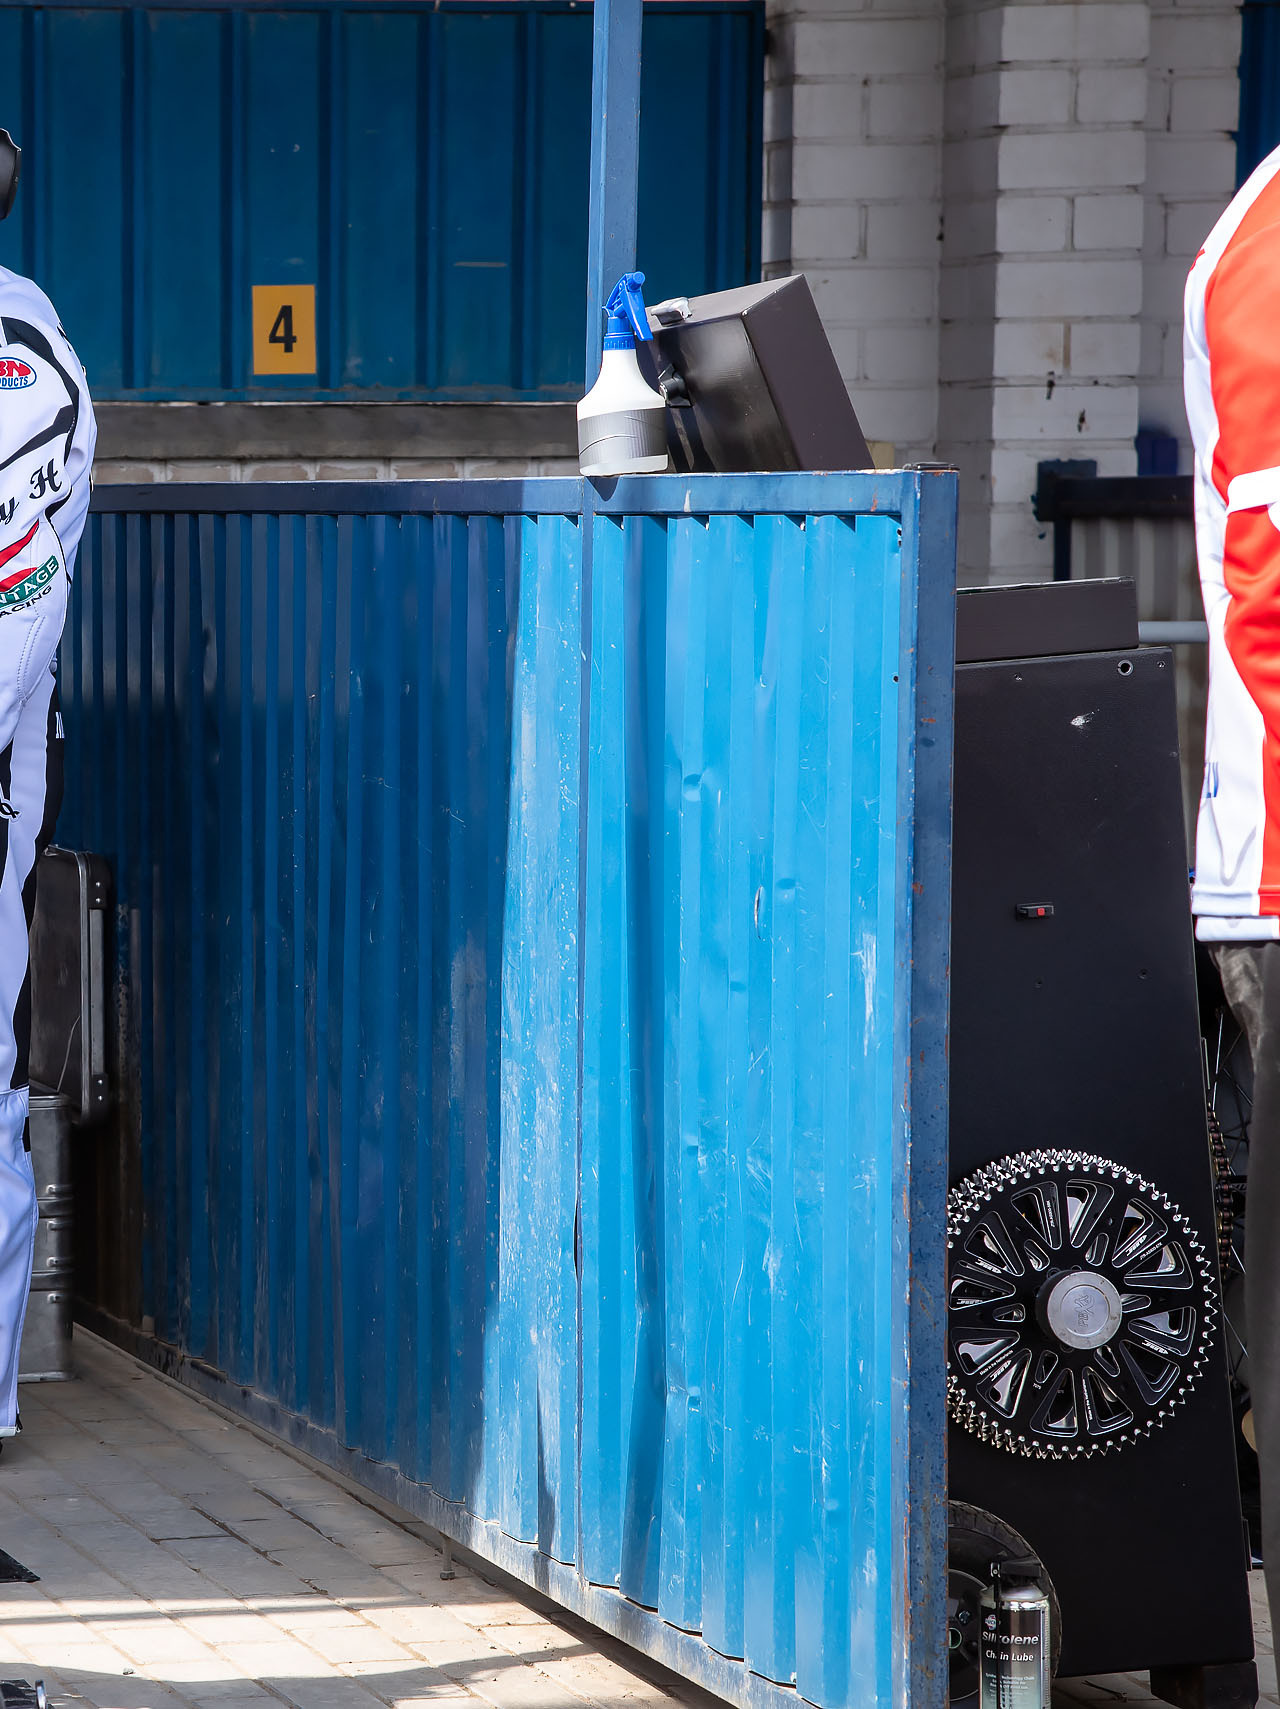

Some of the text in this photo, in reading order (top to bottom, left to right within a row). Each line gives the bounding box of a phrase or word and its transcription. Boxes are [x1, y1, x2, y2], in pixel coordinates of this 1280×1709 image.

[269, 304, 297, 353] 4
[29, 457, 63, 499] H
[982, 1631, 1039, 1645] Silolene
[986, 1649, 1034, 1662] Chin Lube
